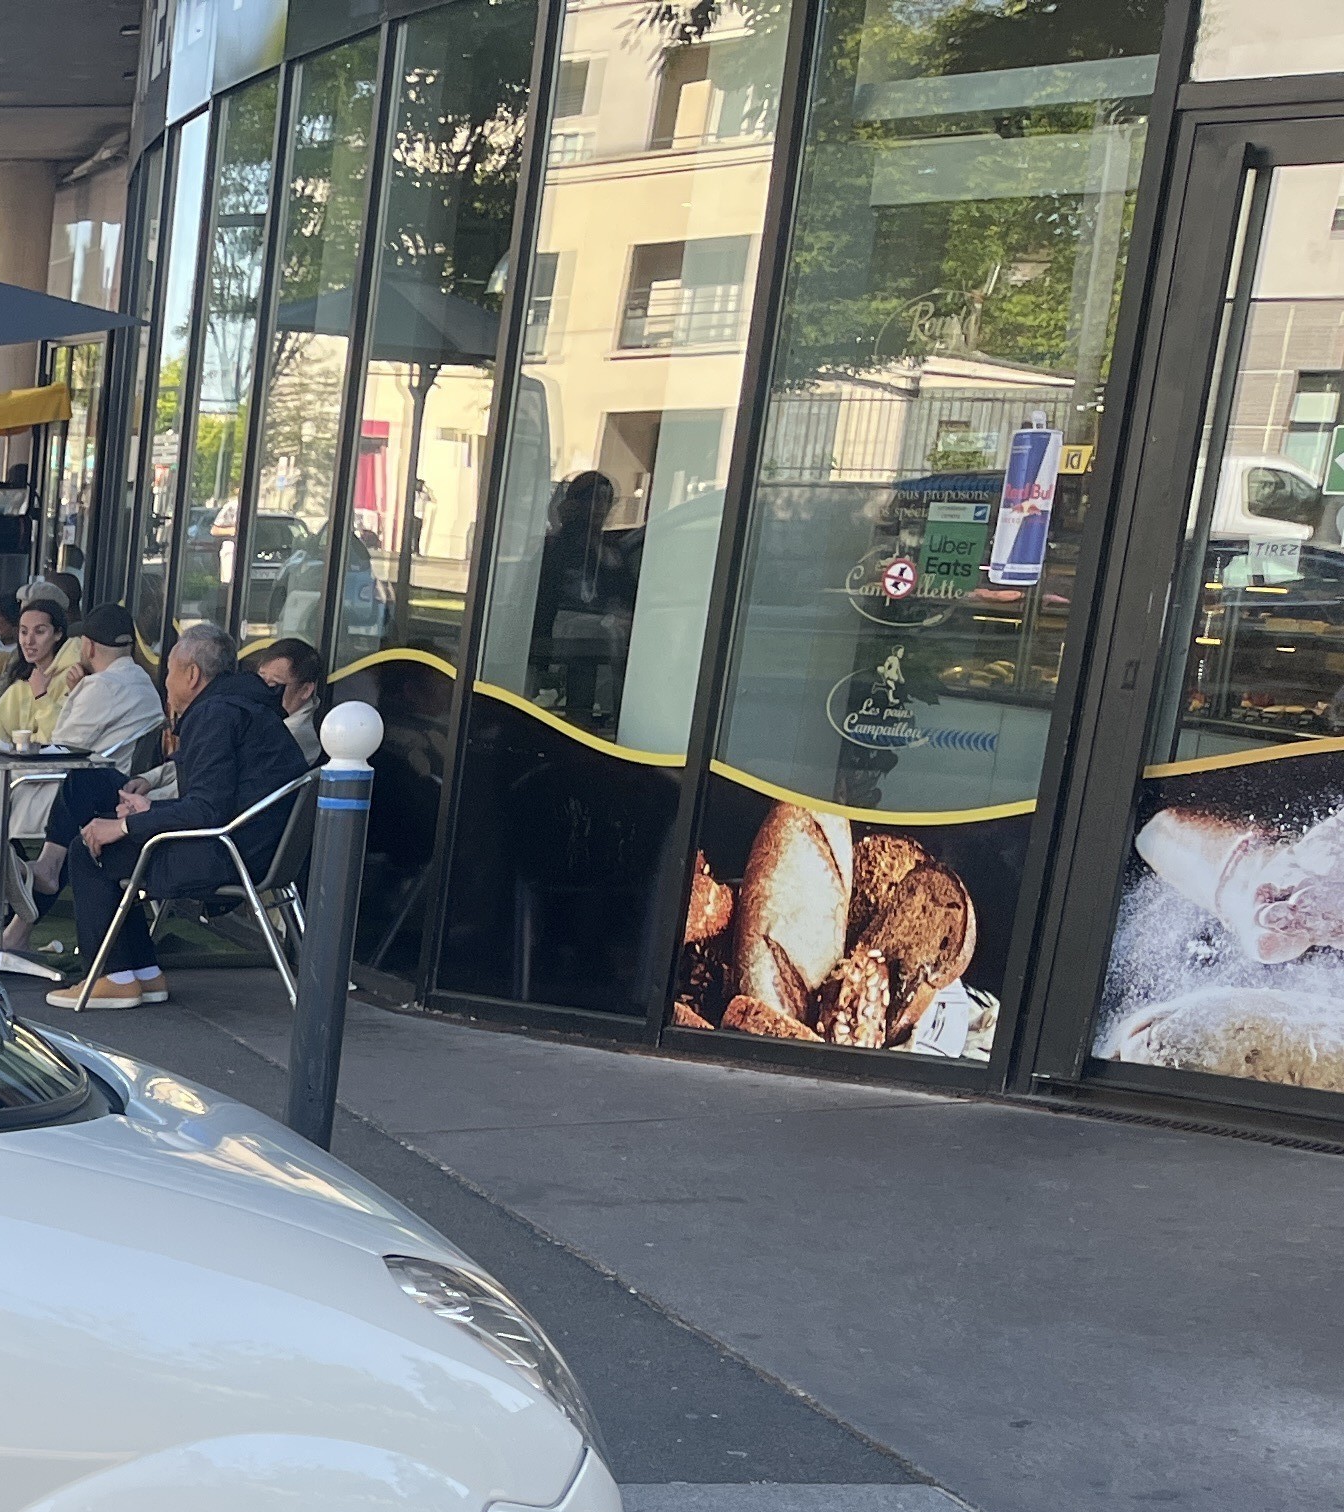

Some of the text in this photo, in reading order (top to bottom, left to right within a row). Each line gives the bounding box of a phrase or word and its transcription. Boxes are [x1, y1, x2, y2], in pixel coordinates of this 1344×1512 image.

[923, 488, 990, 505] proposons
[928, 534, 977, 556] Uber
[1255, 542, 1300, 557] TIREZ
[924, 556, 973, 577] Eats
[845, 565, 966, 607] Camllette
[859, 697, 913, 720] Les pains
[843, 712, 922, 740] Campaillou
